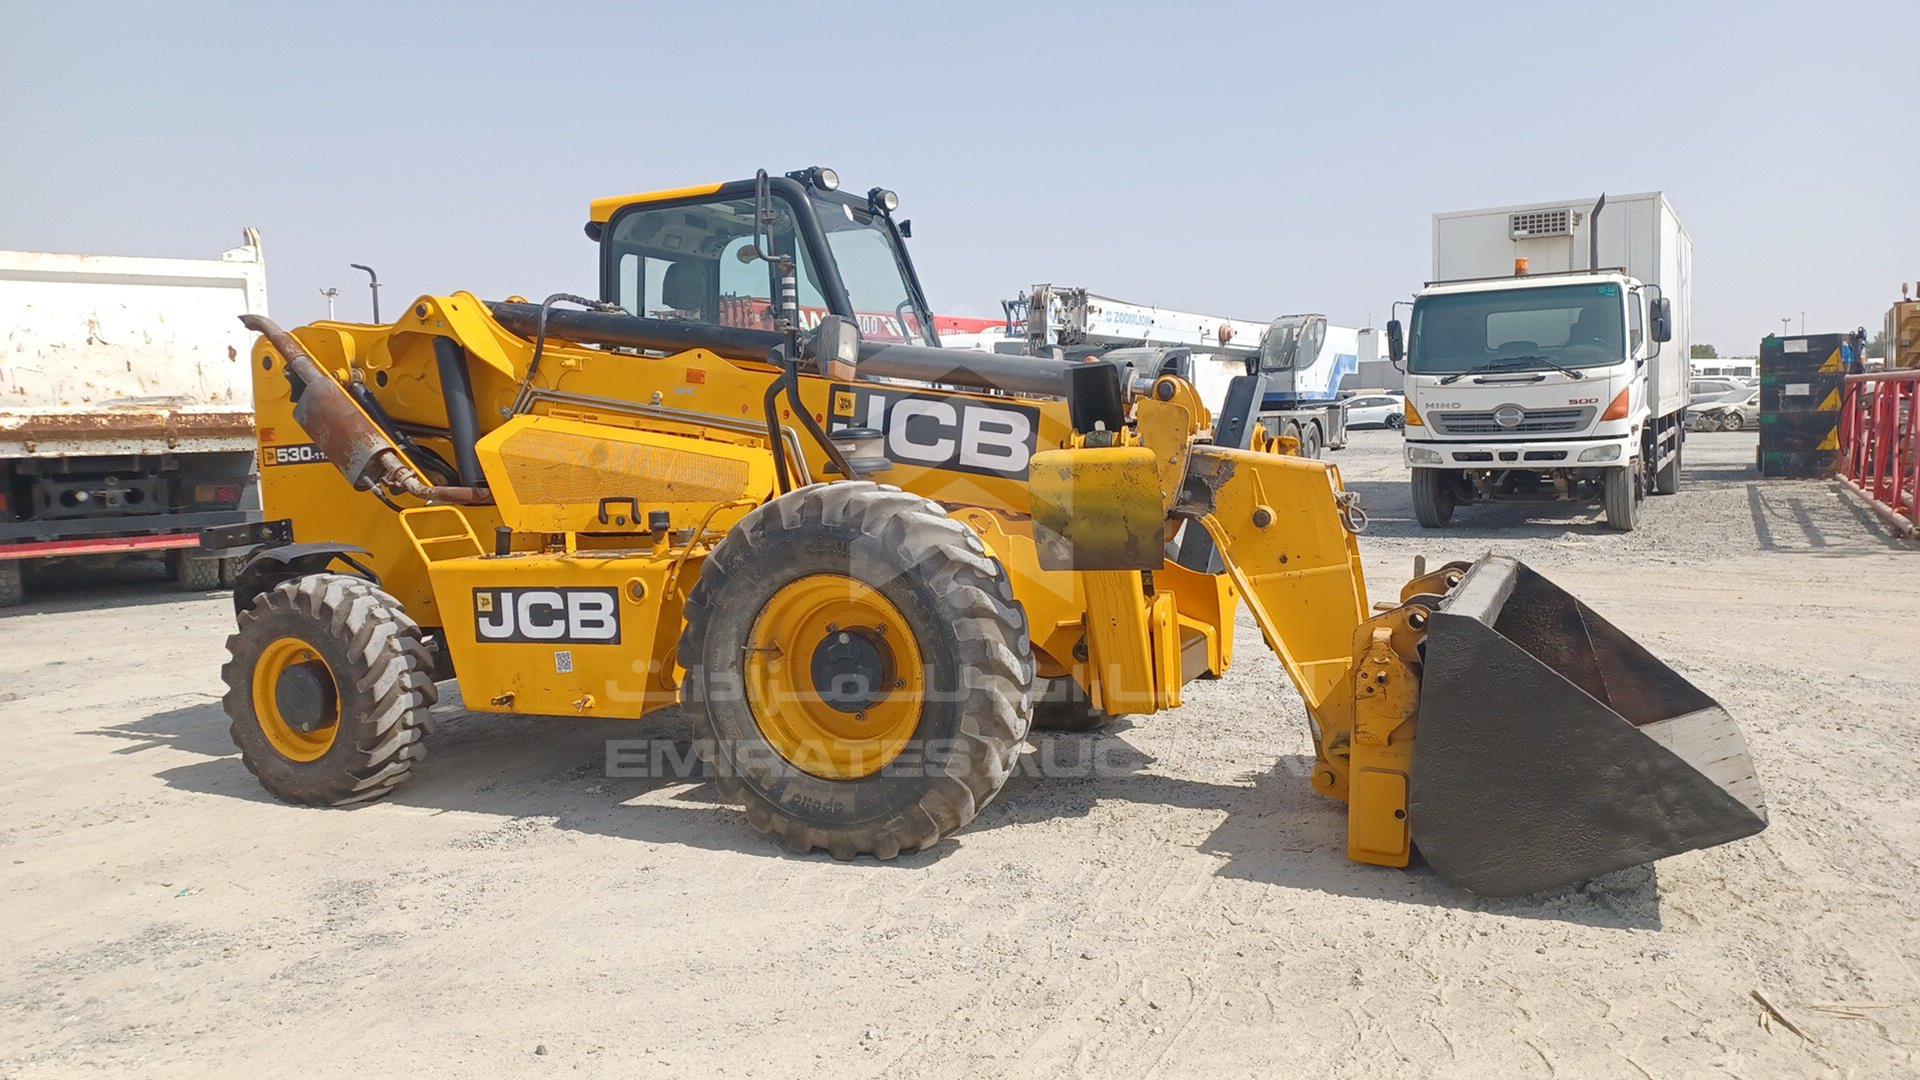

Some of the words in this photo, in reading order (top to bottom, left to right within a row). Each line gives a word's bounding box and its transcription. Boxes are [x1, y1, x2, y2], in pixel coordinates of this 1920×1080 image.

[1568, 397, 1599, 405] 500
[832, 394, 1031, 472] JCB
[276, 446, 329, 463] 530-11
[478, 591, 617, 639] JCB
